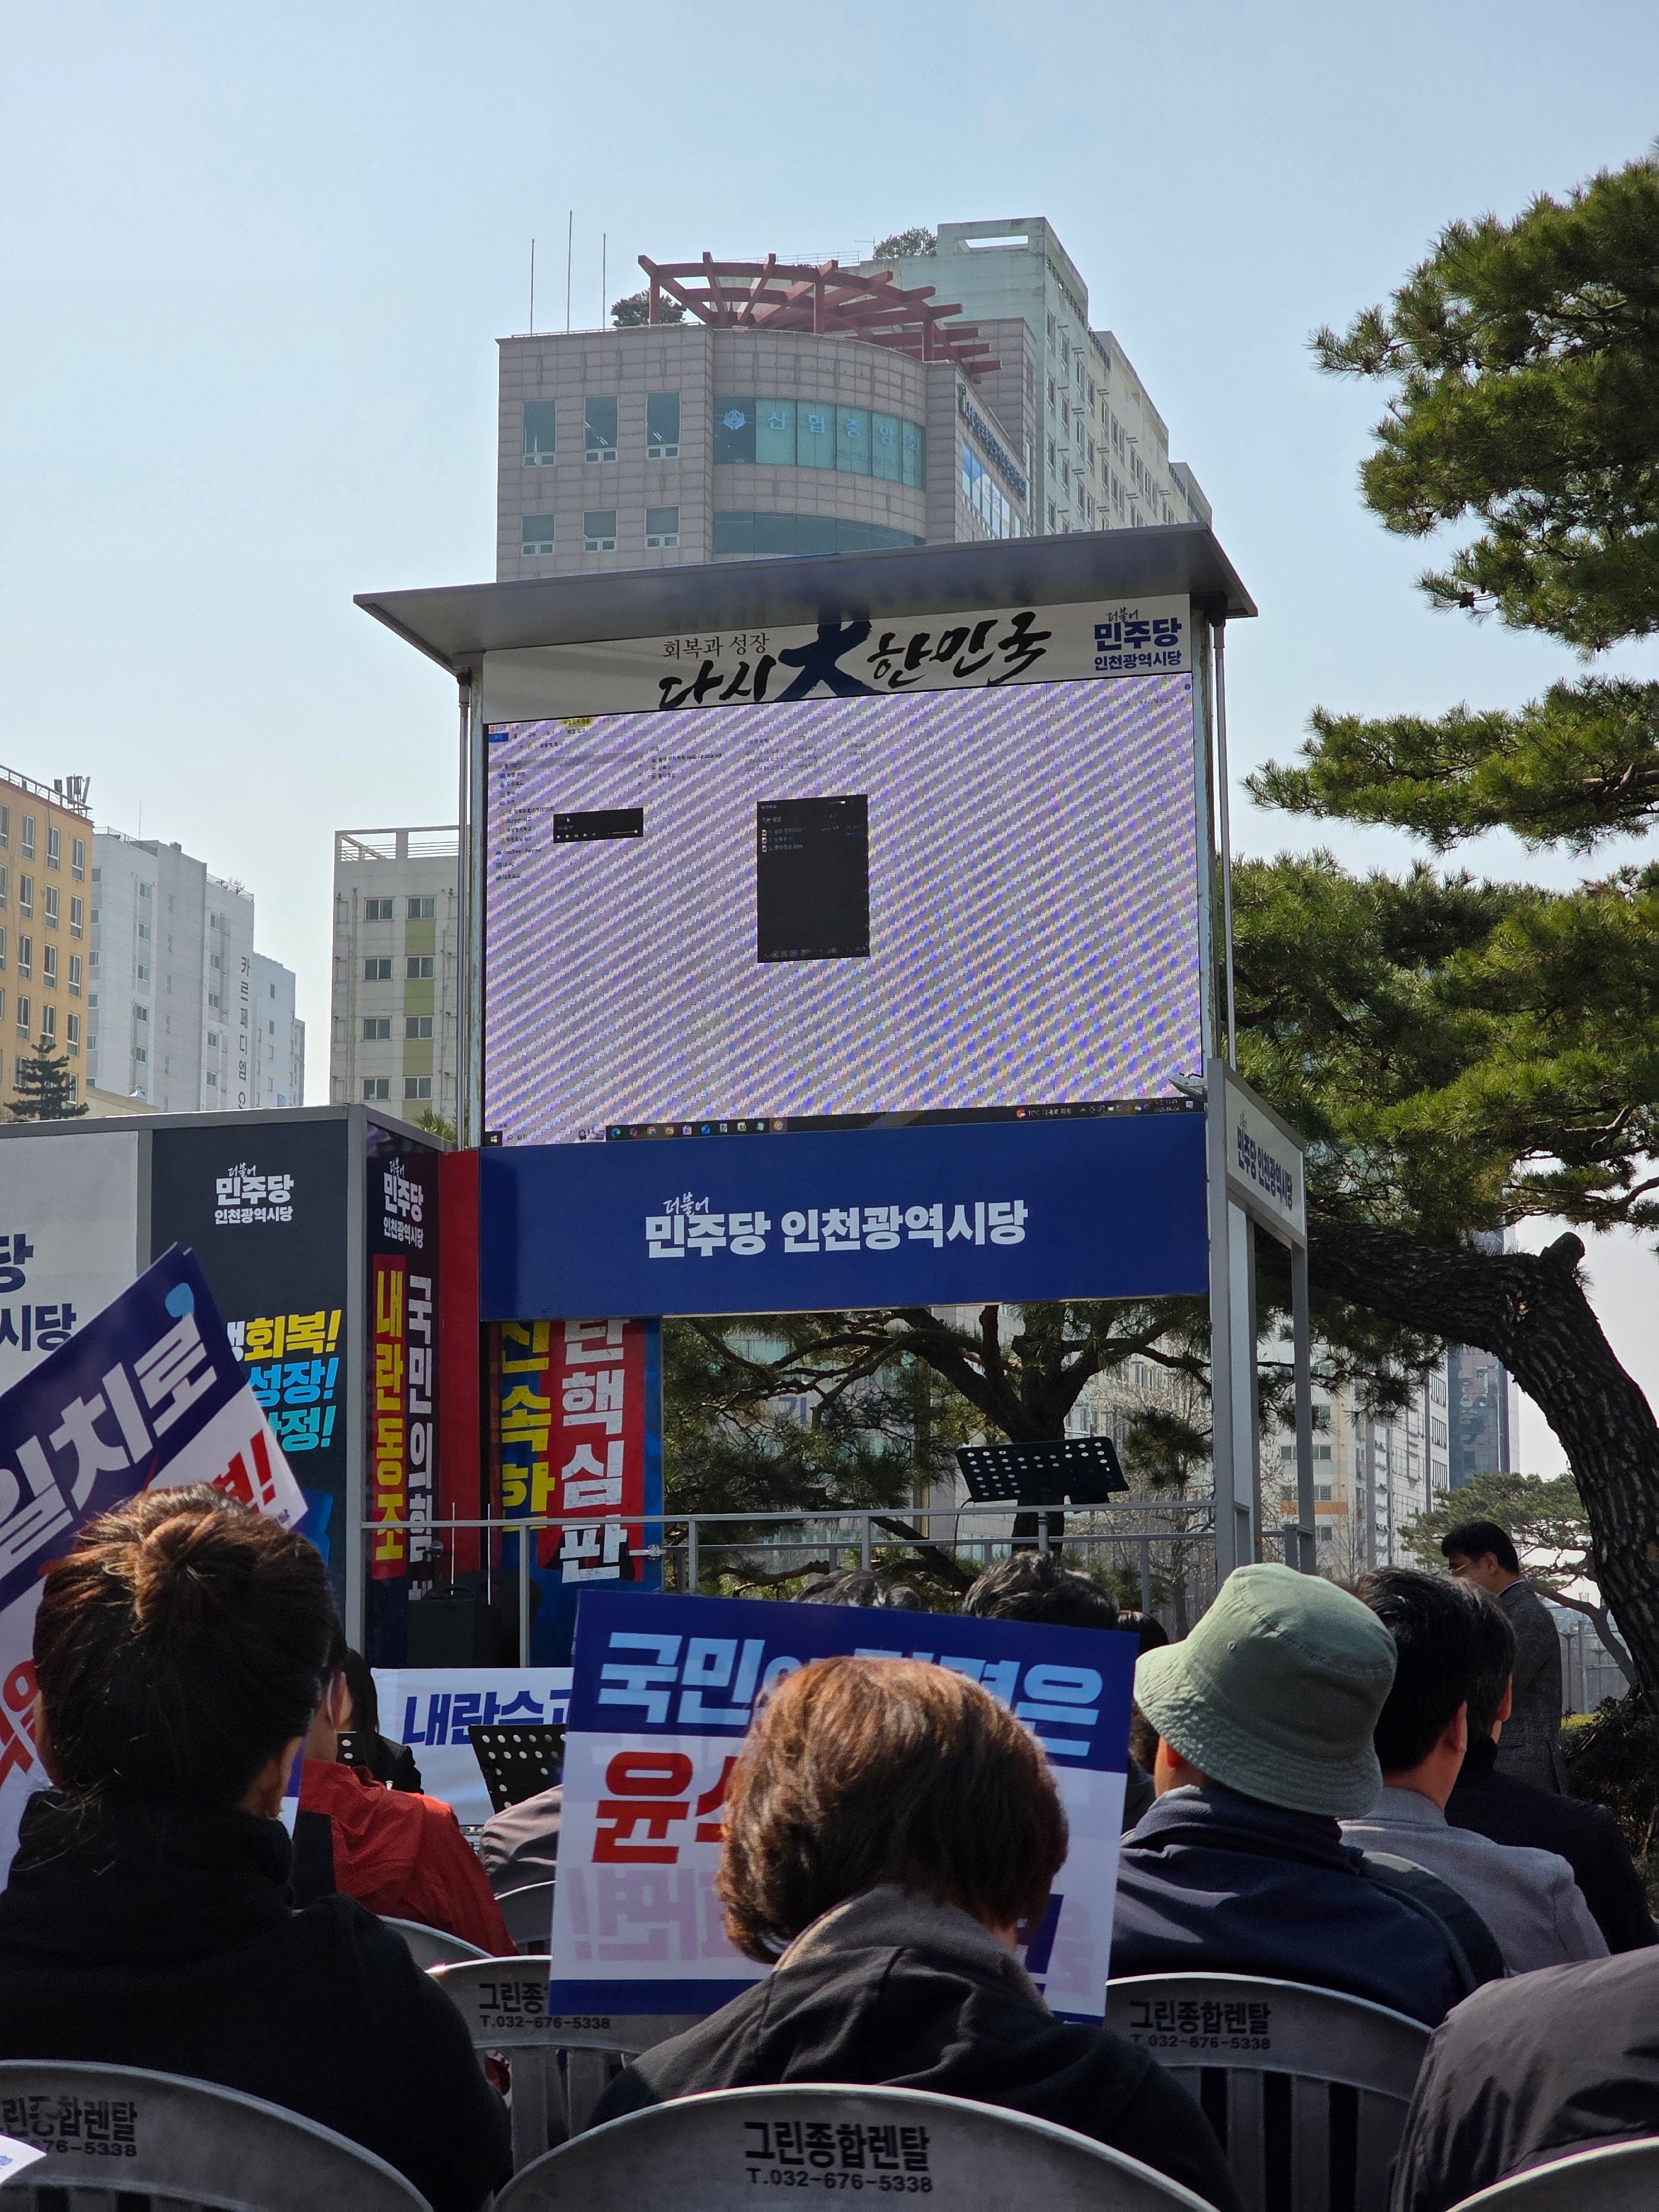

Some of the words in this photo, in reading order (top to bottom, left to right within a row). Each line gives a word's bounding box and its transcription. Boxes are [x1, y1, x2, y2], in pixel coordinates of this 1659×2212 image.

[768, 411, 921, 455] 신협중앙회
[1107, 607, 1139, 623] 더불어
[663, 636, 724, 660] 회복과
[729, 632, 770, 655] 성장
[1094, 618, 1182, 651] 민주당
[1094, 650, 1182, 671] 인천광역시당
[659, 655, 776, 709] 다시
[239, 956, 251, 1081] 카르페디엠
[227, 1162, 256, 1178] 더불어
[389, 1156, 405, 1179] 더불어
[1237, 1126, 1256, 1180] 민주당
[1258, 1146, 1293, 1211] 인천광역시당
[216, 1175, 294, 1206] 민주당
[384, 1172, 424, 1222] 민주당
[663, 1192, 709, 1217] 더불어
[215, 1206, 293, 1224] 인천광역시당
[646, 1211, 771, 1258] 민주당
[781, 1199, 1028, 1253] 인천광역시당
[383, 1217, 424, 1249] 인천광역시당
[0, 1303, 77, 1351] 시당
[249, 1358, 339, 1407] 성장!
[267, 1406, 336, 1452] 정!
[376, 1270, 403, 1561] 내란동조
[408, 1275, 432, 1563] 국민의힘
[502, 1321, 555, 1532] 신속한
[560, 1319, 630, 1583] 탄핵심판
[479, 1977, 550, 2013] 그린종
[479, 2015, 610, 2029] T.032-676-5338
[1129, 2000, 1271, 2034] 그린종합렌탈
[1131, 2034, 1271, 2049] T032-676-5338
[31, 2138, 137, 2157] 76-5338
[744, 2121, 931, 2171] 그린종합렌탈
[747, 2167, 933, 2193] T.032-676-5338
